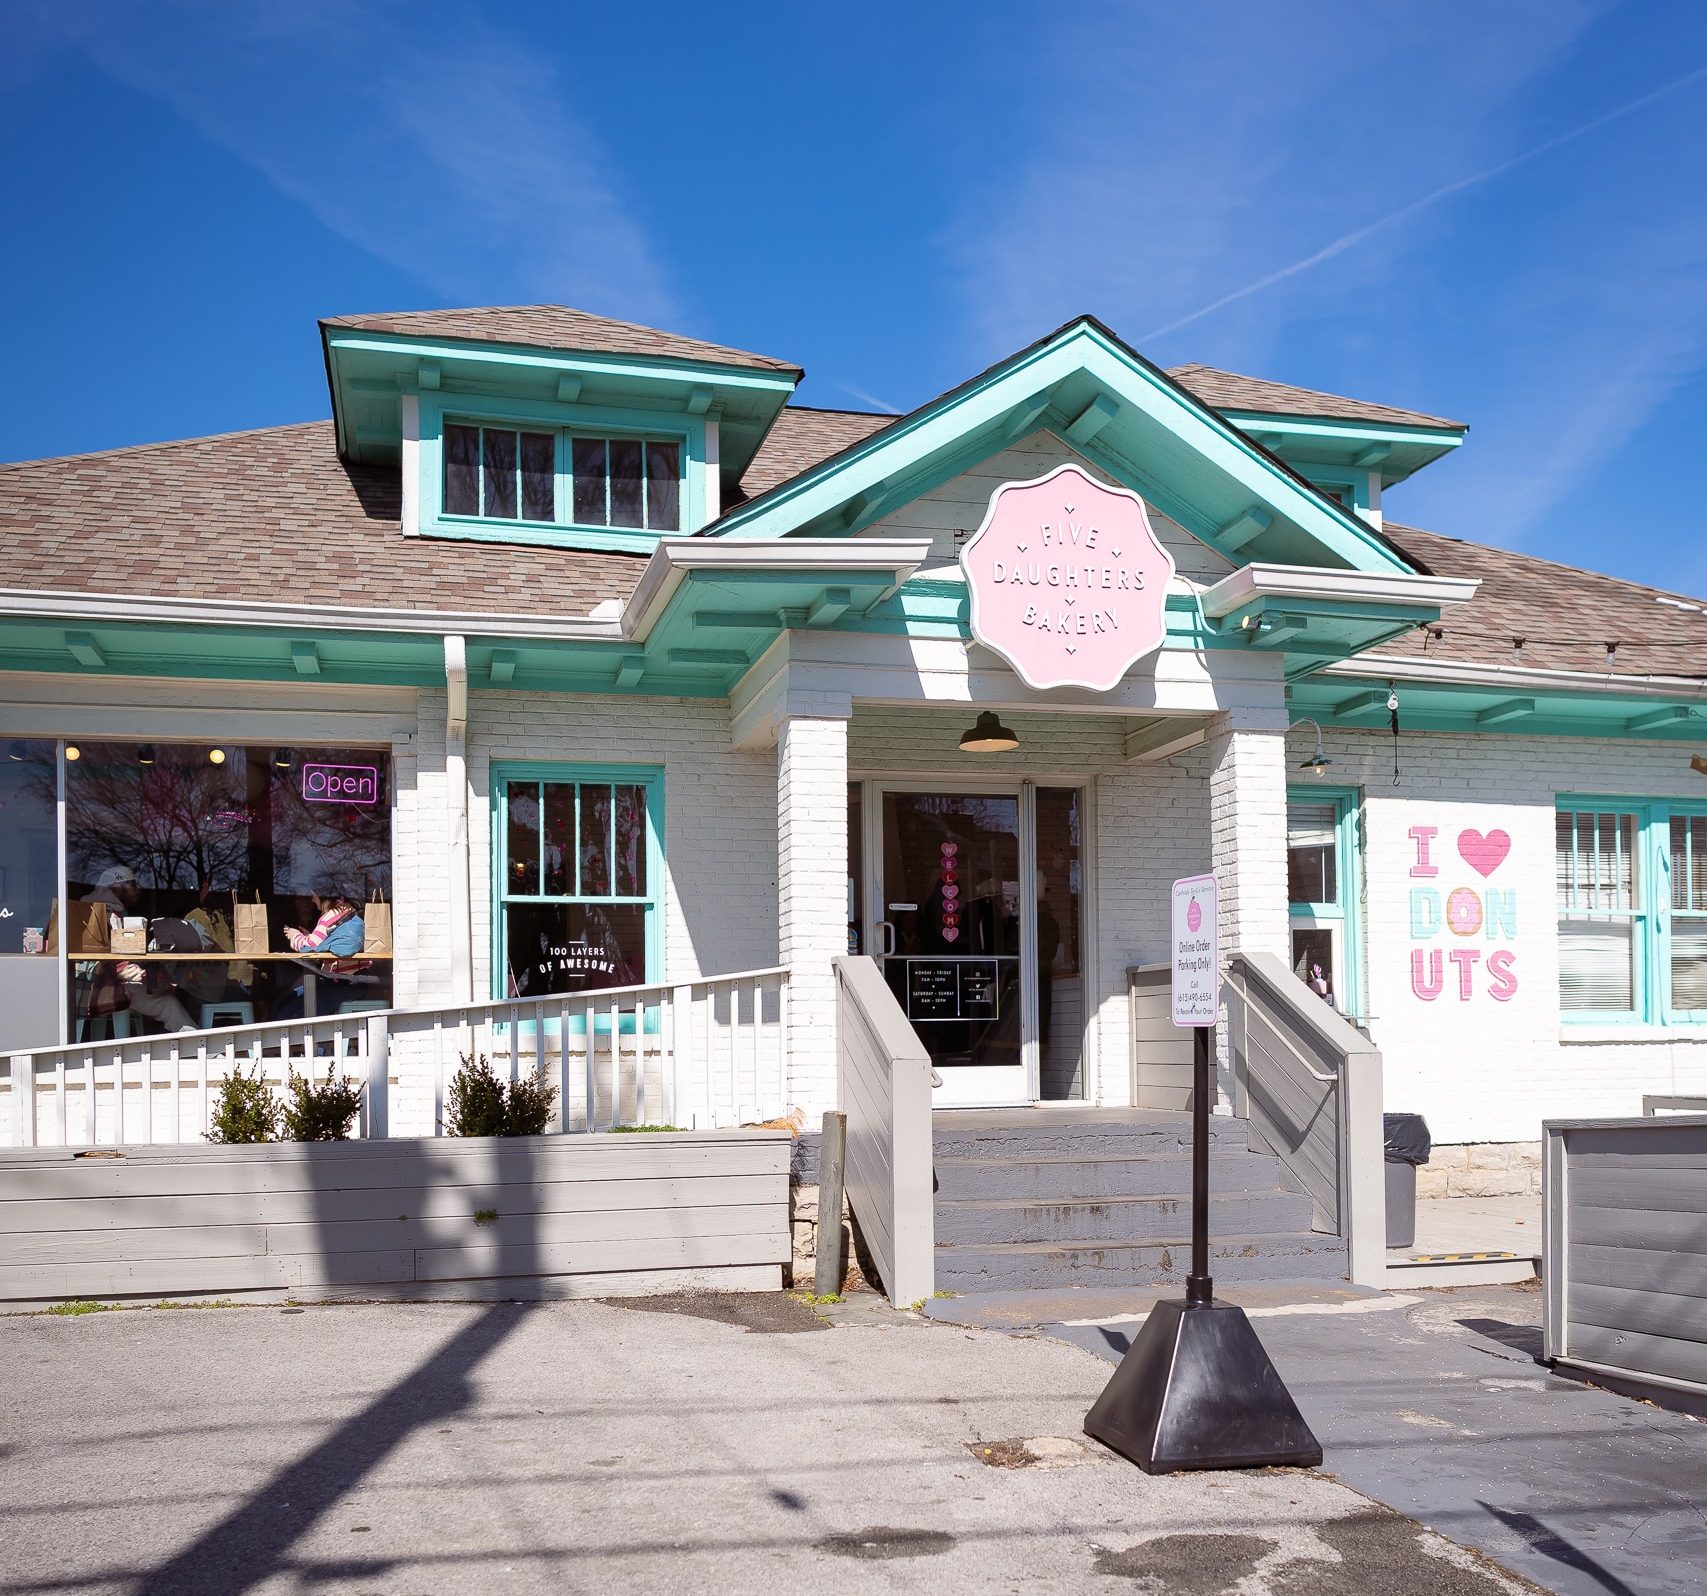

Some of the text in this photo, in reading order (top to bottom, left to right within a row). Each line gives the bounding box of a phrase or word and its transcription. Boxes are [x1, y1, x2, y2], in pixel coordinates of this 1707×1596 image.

[1041, 522, 1099, 550] FIVE
[993, 561, 1146, 591] DAUGHTERS
[1022, 603, 1120, 636] BAKERY
[308, 771, 372, 797] Open
[1408, 826, 1438, 878] I
[1410, 886, 1518, 940] DON
[550, 947, 605, 956] 100 LAYERS
[1179, 939, 1210, 953] Online Order
[539, 958, 615, 974] OF AWESOME
[1178, 956, 1211, 972] Parking Only!
[1410, 948, 1518, 1001] UTS
[1190, 980, 1199, 989] Call
[1177, 992, 1212, 1004] (615)490-6554
[1203, 1007, 1214, 1015] Order
